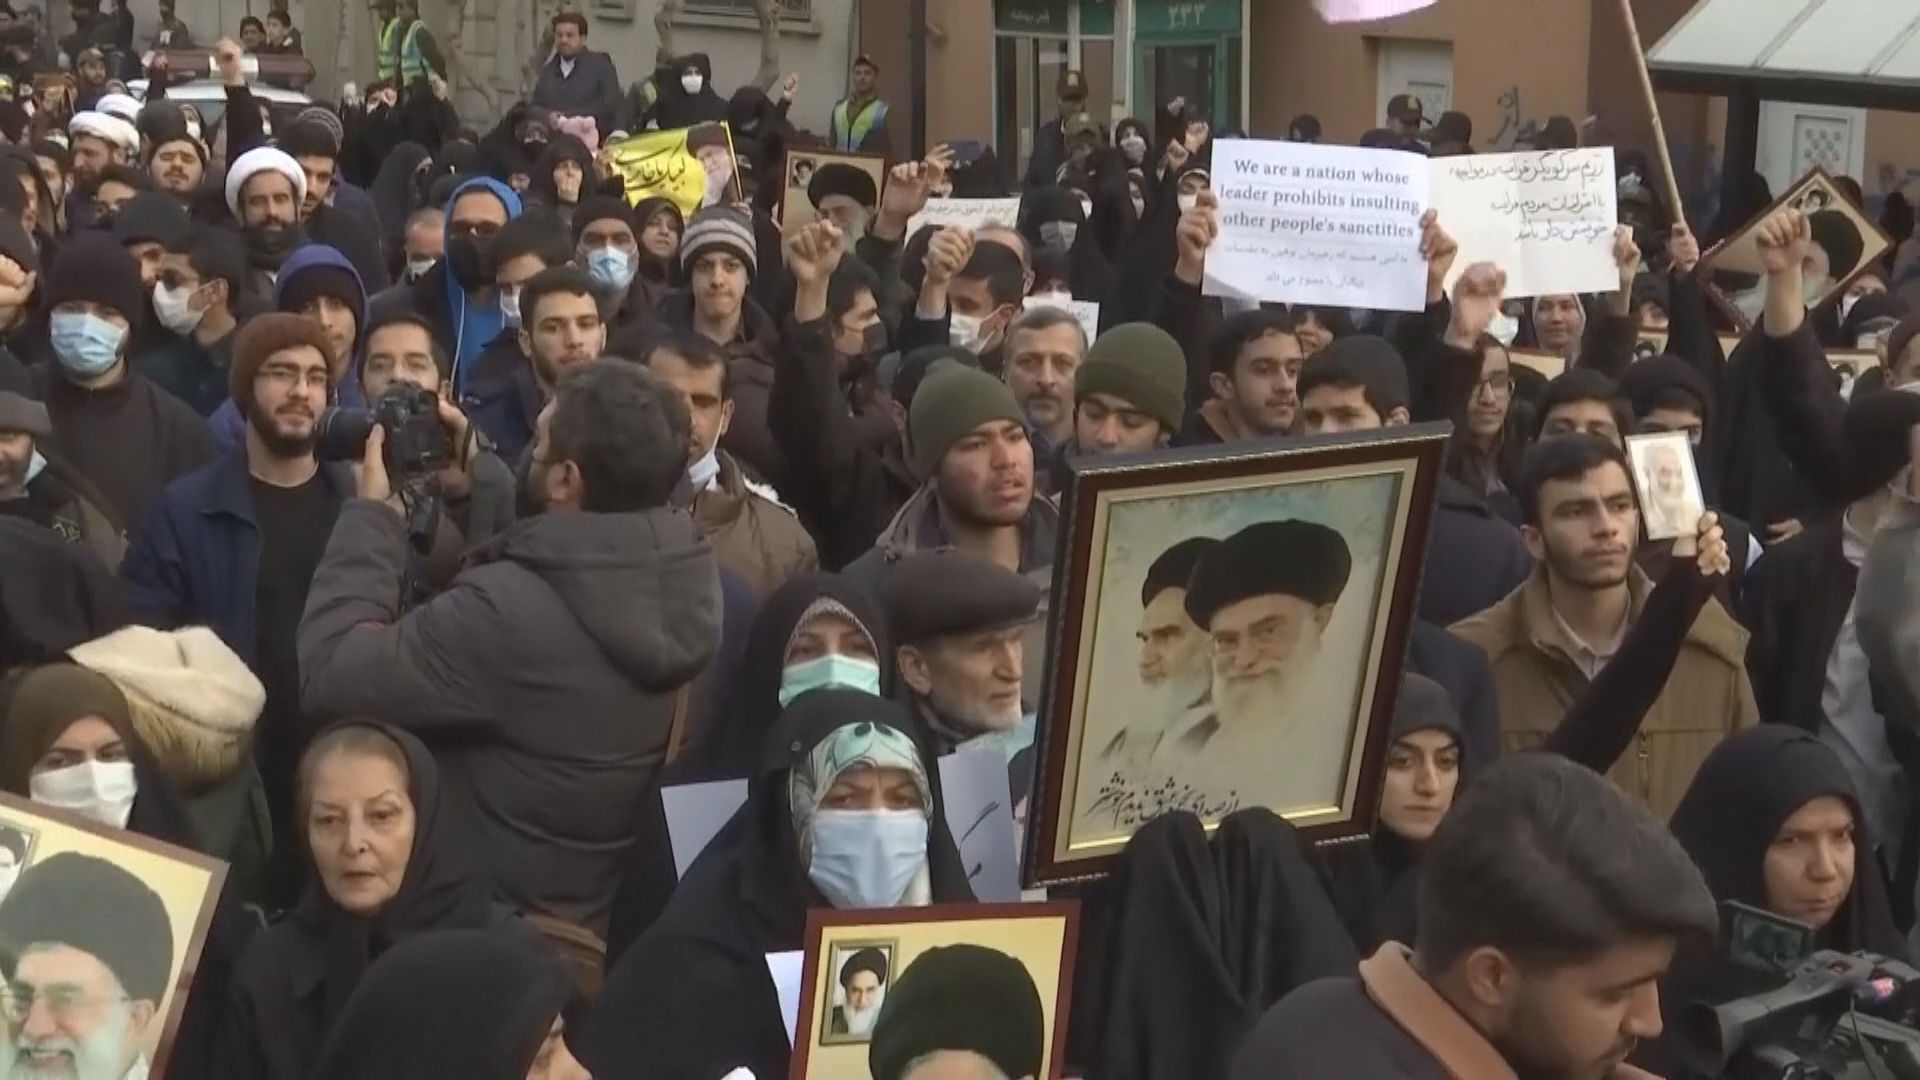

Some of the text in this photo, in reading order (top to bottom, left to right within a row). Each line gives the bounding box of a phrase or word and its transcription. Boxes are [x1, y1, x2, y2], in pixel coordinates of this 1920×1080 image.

[1234, 159, 1410, 185] We are a nation whose
[1220, 184, 1420, 216] leader prohibits insulting
[1223, 213, 1414, 238] other people's sanctities
